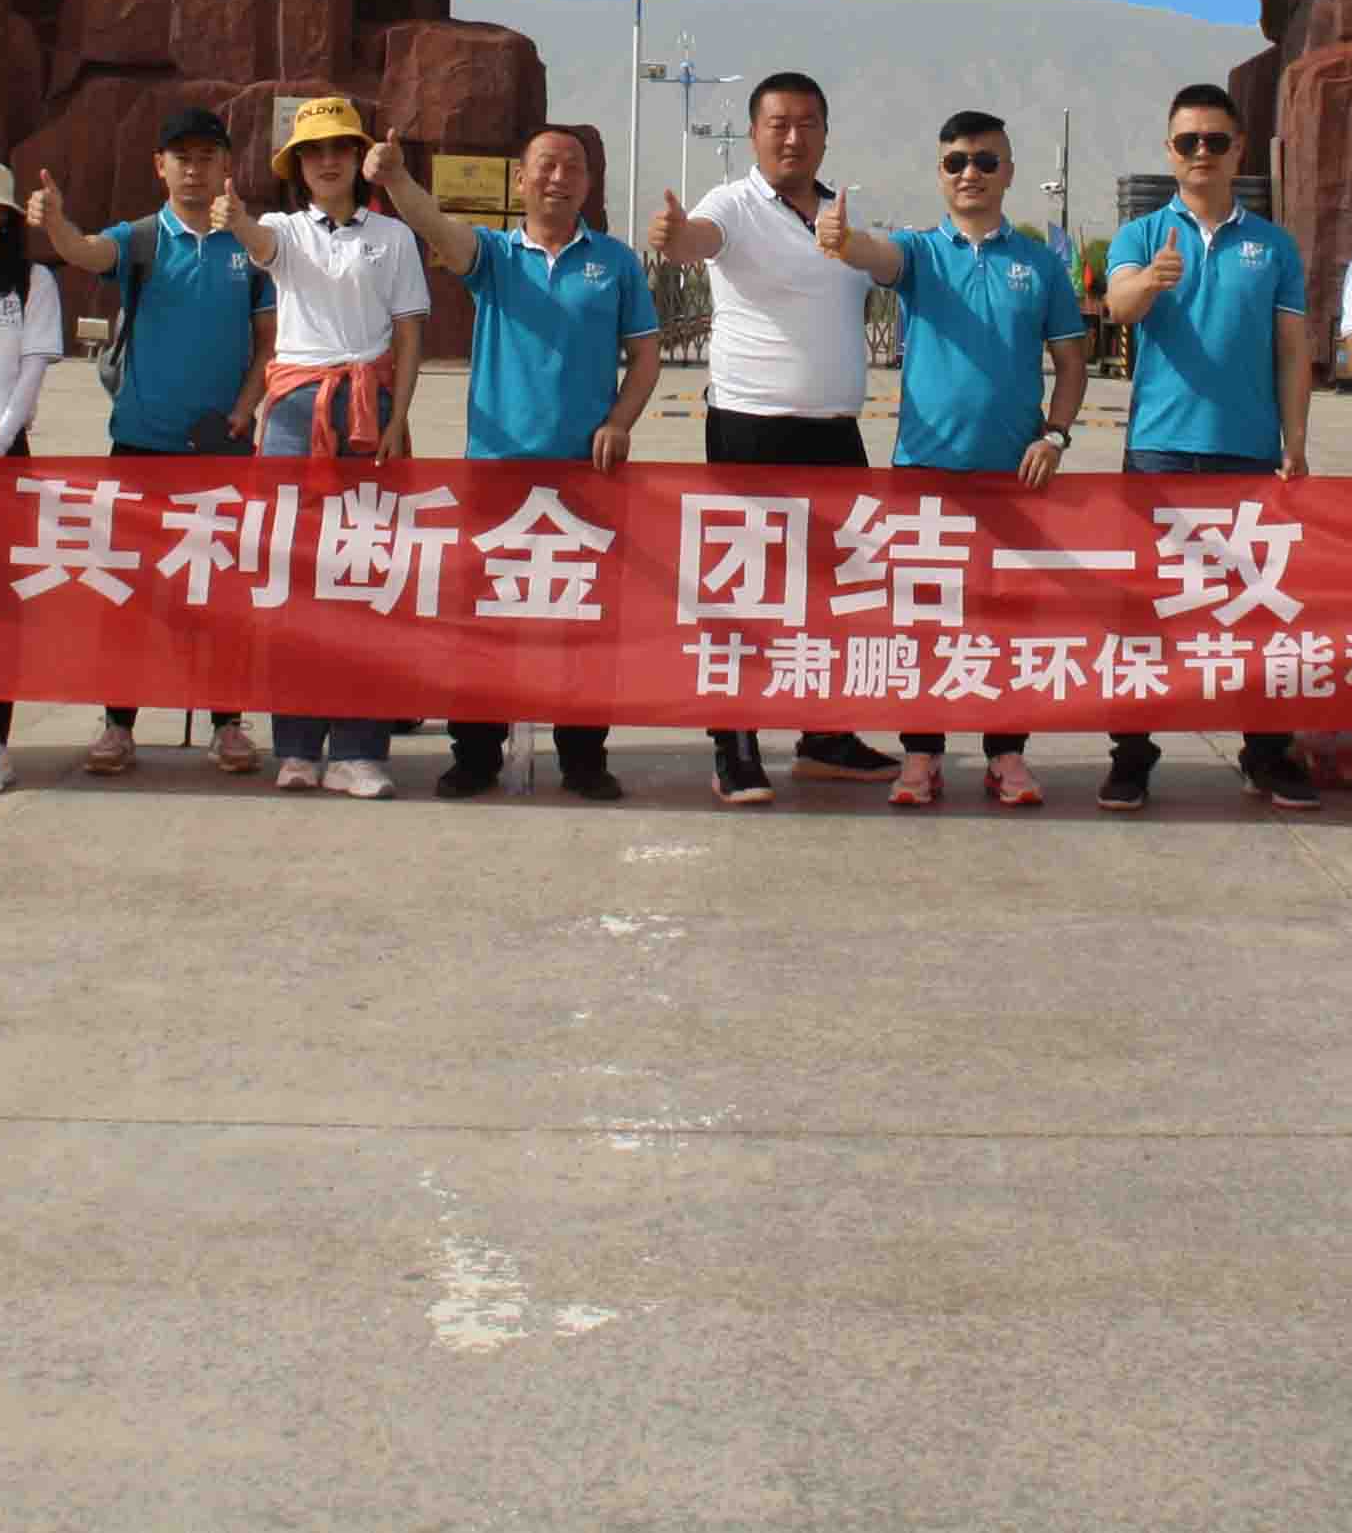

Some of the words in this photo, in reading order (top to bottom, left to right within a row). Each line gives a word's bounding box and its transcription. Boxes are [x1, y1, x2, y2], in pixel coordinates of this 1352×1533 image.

[9, 477, 616, 620] 其利断金
[676, 493, 1304, 627] 团结一致
